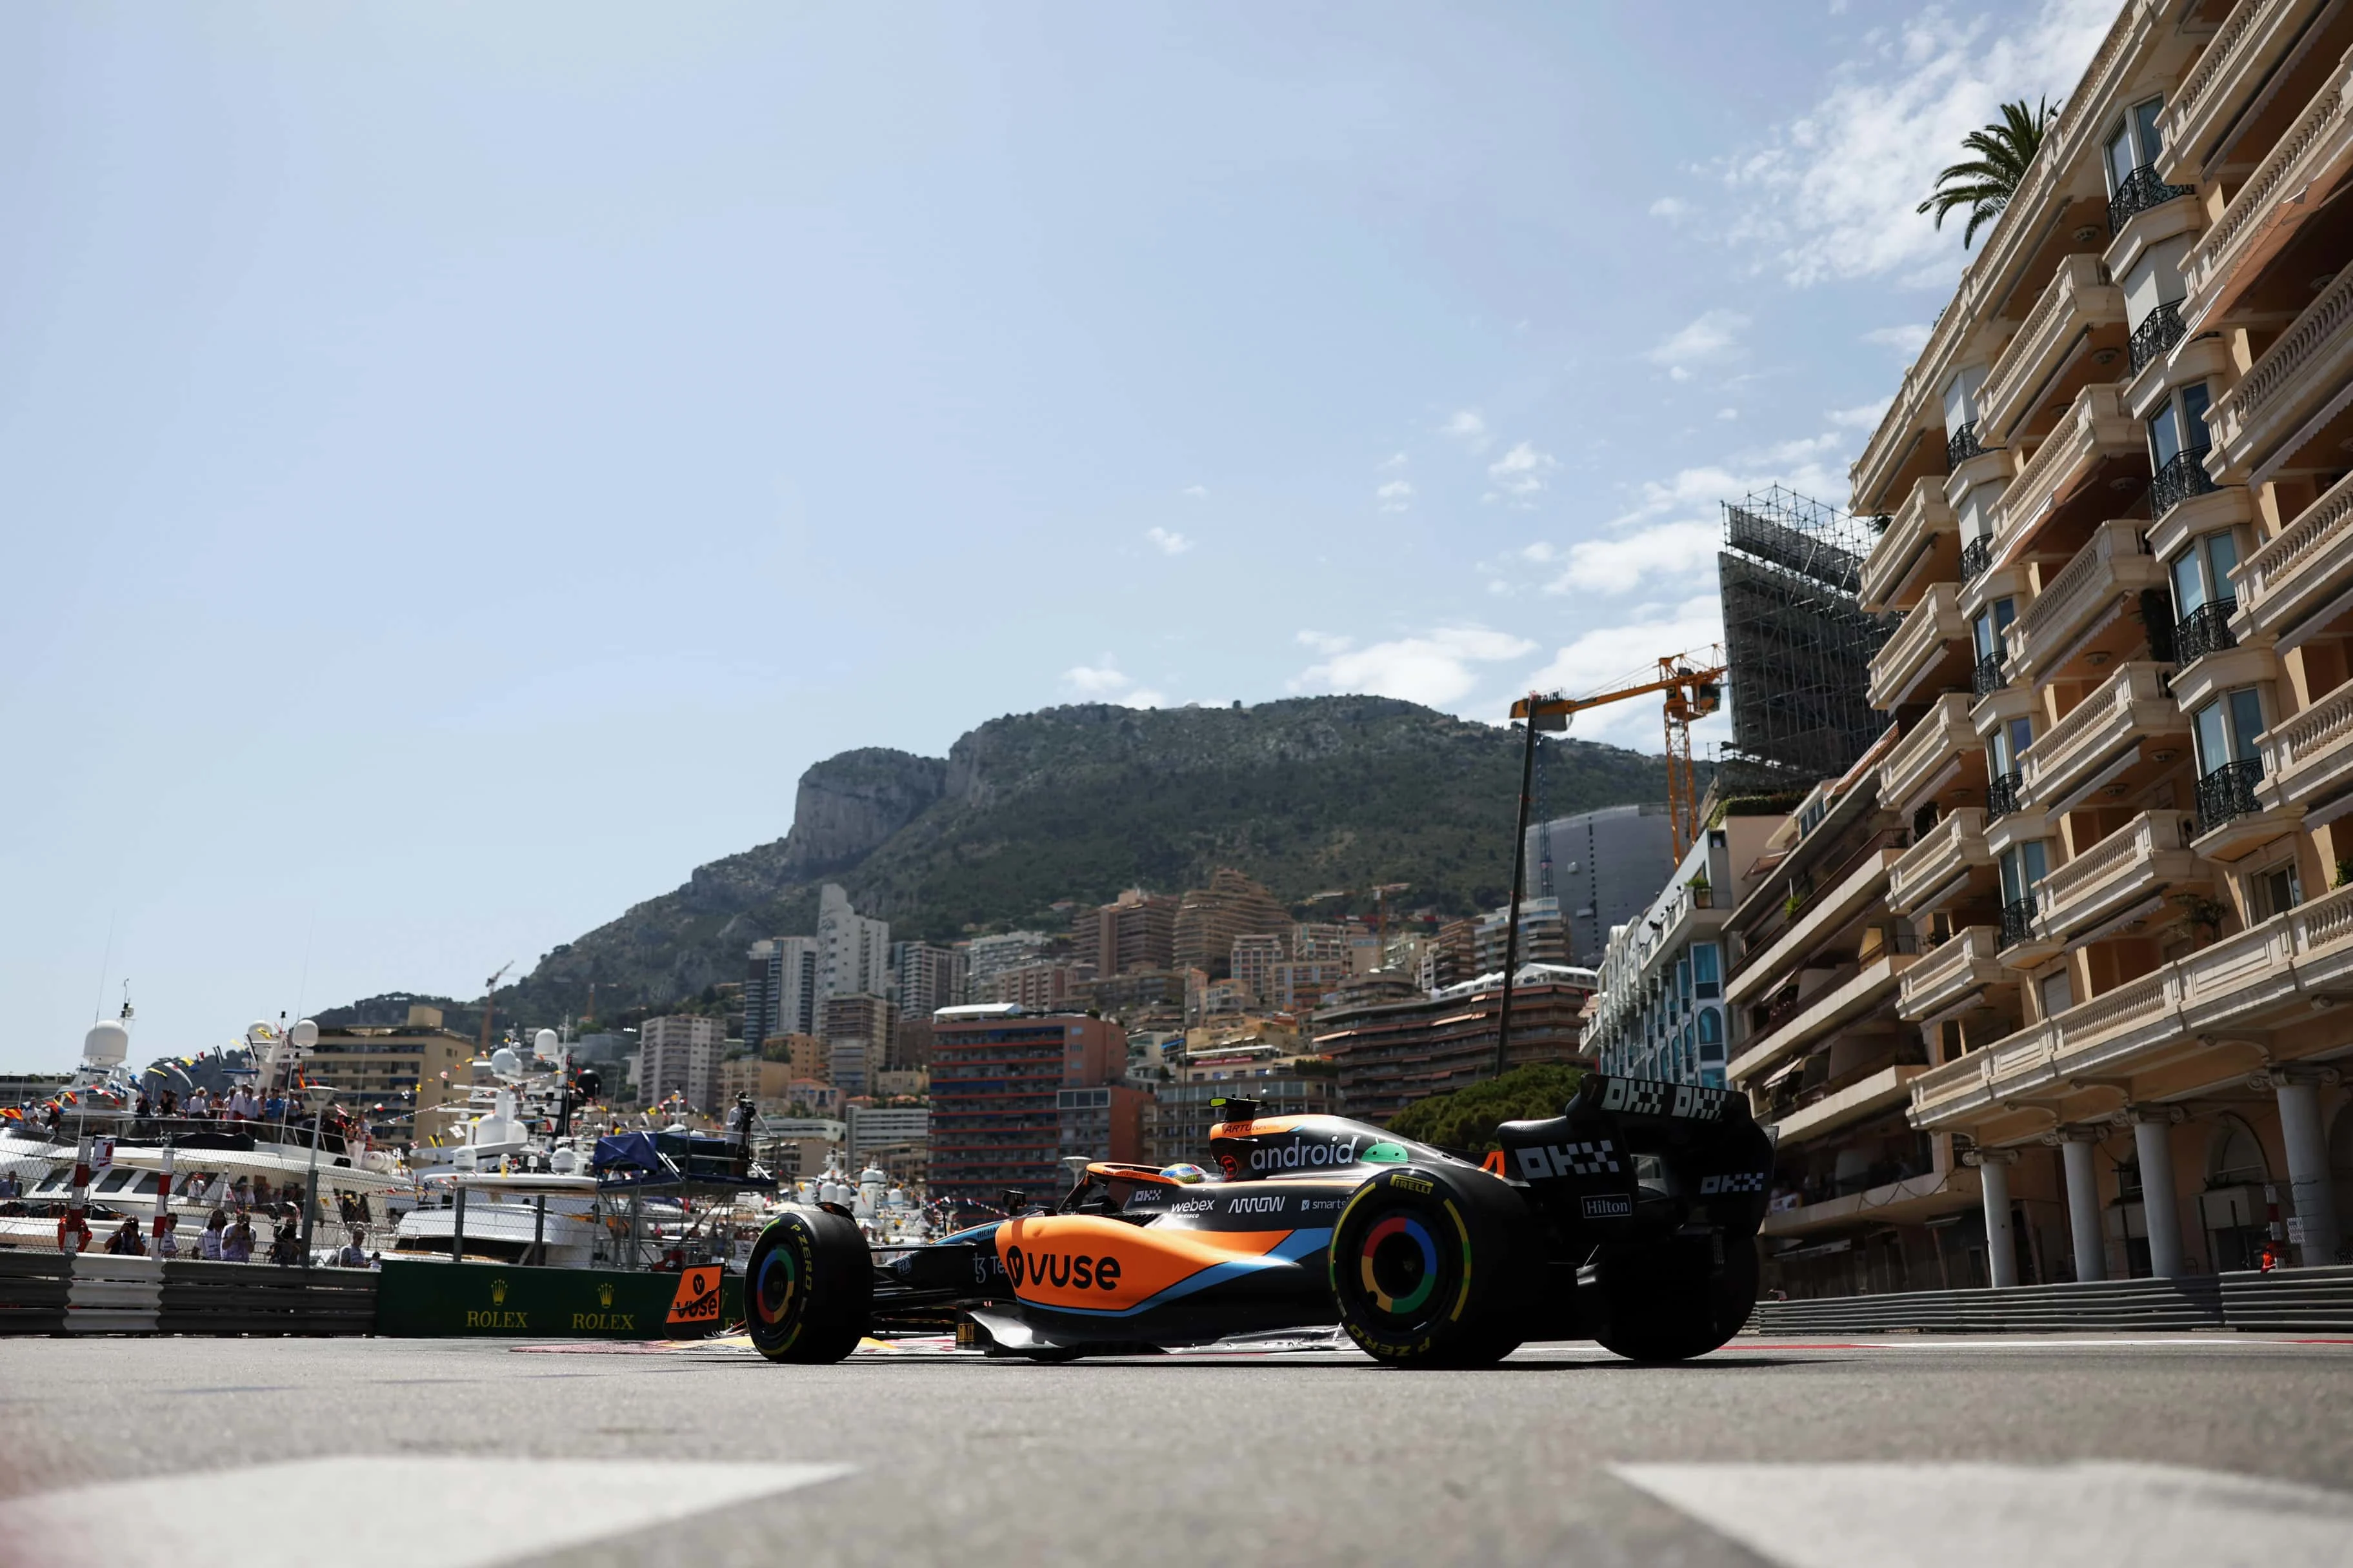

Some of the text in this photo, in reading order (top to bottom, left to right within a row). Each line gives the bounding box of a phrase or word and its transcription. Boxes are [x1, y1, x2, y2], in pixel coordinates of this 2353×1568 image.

[1600, 1077, 1727, 1120] OKX OKX
[1250, 1135, 1358, 1170] android
[1515, 1140, 1619, 1180] OKX
[1390, 1174, 1434, 1195] PIRELLI
[1700, 1173, 1763, 1195] OKX
[1134, 1189, 1162, 1202] OKX
[1172, 1198, 1214, 1213] webex
[1312, 1196, 1348, 1210] smarts
[1587, 1200, 1628, 1215] Hilton
[790, 1224, 812, 1291] P ZERO
[990, 1256, 1008, 1275] Te
[1027, 1253, 1121, 1291] vuse
[466, 1311, 529, 1328] ROLEX
[572, 1313, 635, 1330] ROLEX
[1349, 1324, 1430, 1356] P ZERO
